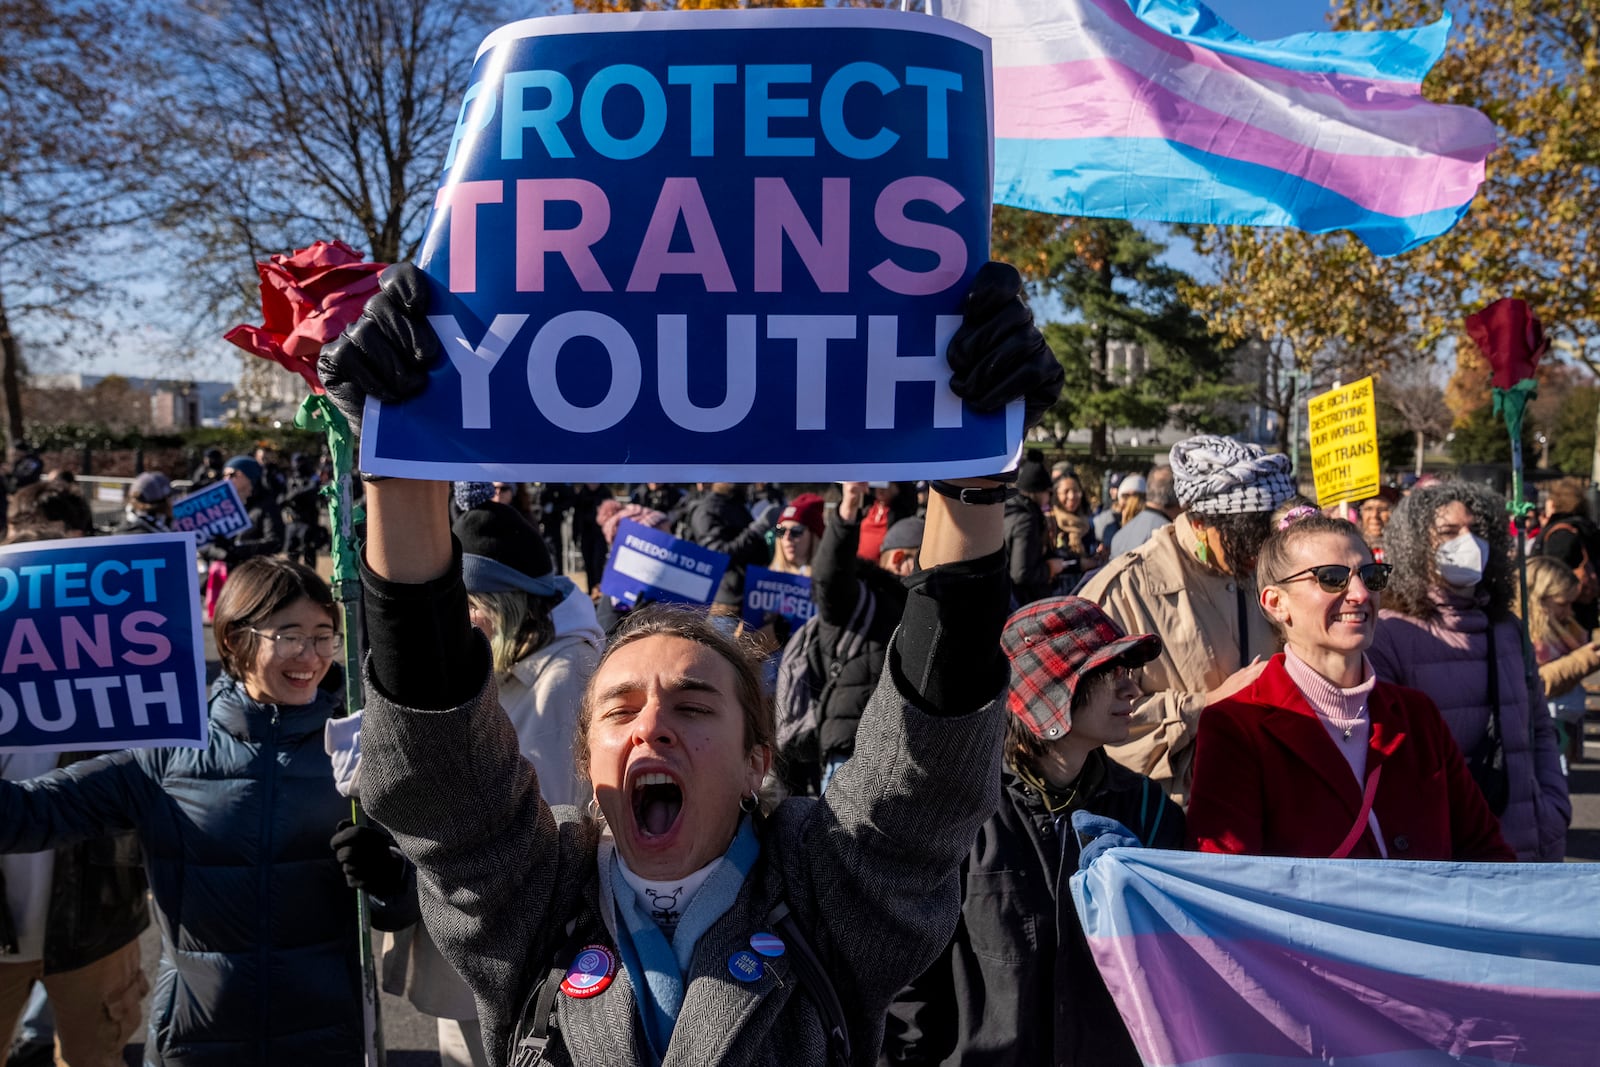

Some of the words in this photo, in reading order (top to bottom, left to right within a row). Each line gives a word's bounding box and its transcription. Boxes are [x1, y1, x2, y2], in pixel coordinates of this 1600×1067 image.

[443, 61, 963, 170] PROTECT
[434, 176, 968, 296] TRANS
[427, 310, 963, 434] YOUTH
[1310, 401, 1325, 416] THE
[1328, 393, 1348, 408] RICH
[1352, 386, 1369, 400] ARE
[1311, 402, 1367, 432] DESTROYING
[1312, 432, 1328, 449] OUR
[1330, 421, 1368, 442] WORLD,
[1313, 451, 1331, 470] NOT
[1335, 439, 1374, 463] TRANS
[1316, 464, 1351, 488] YOUTH!
[625, 535, 678, 563] FREEDOM
[679, 555, 696, 569] TO
[696, 561, 713, 576] BE
[756, 580, 811, 598] FREEDOM
[1, 610, 172, 674] ANS
[734, 958, 753, 976] HER
[740, 954, 759, 969] SHE
